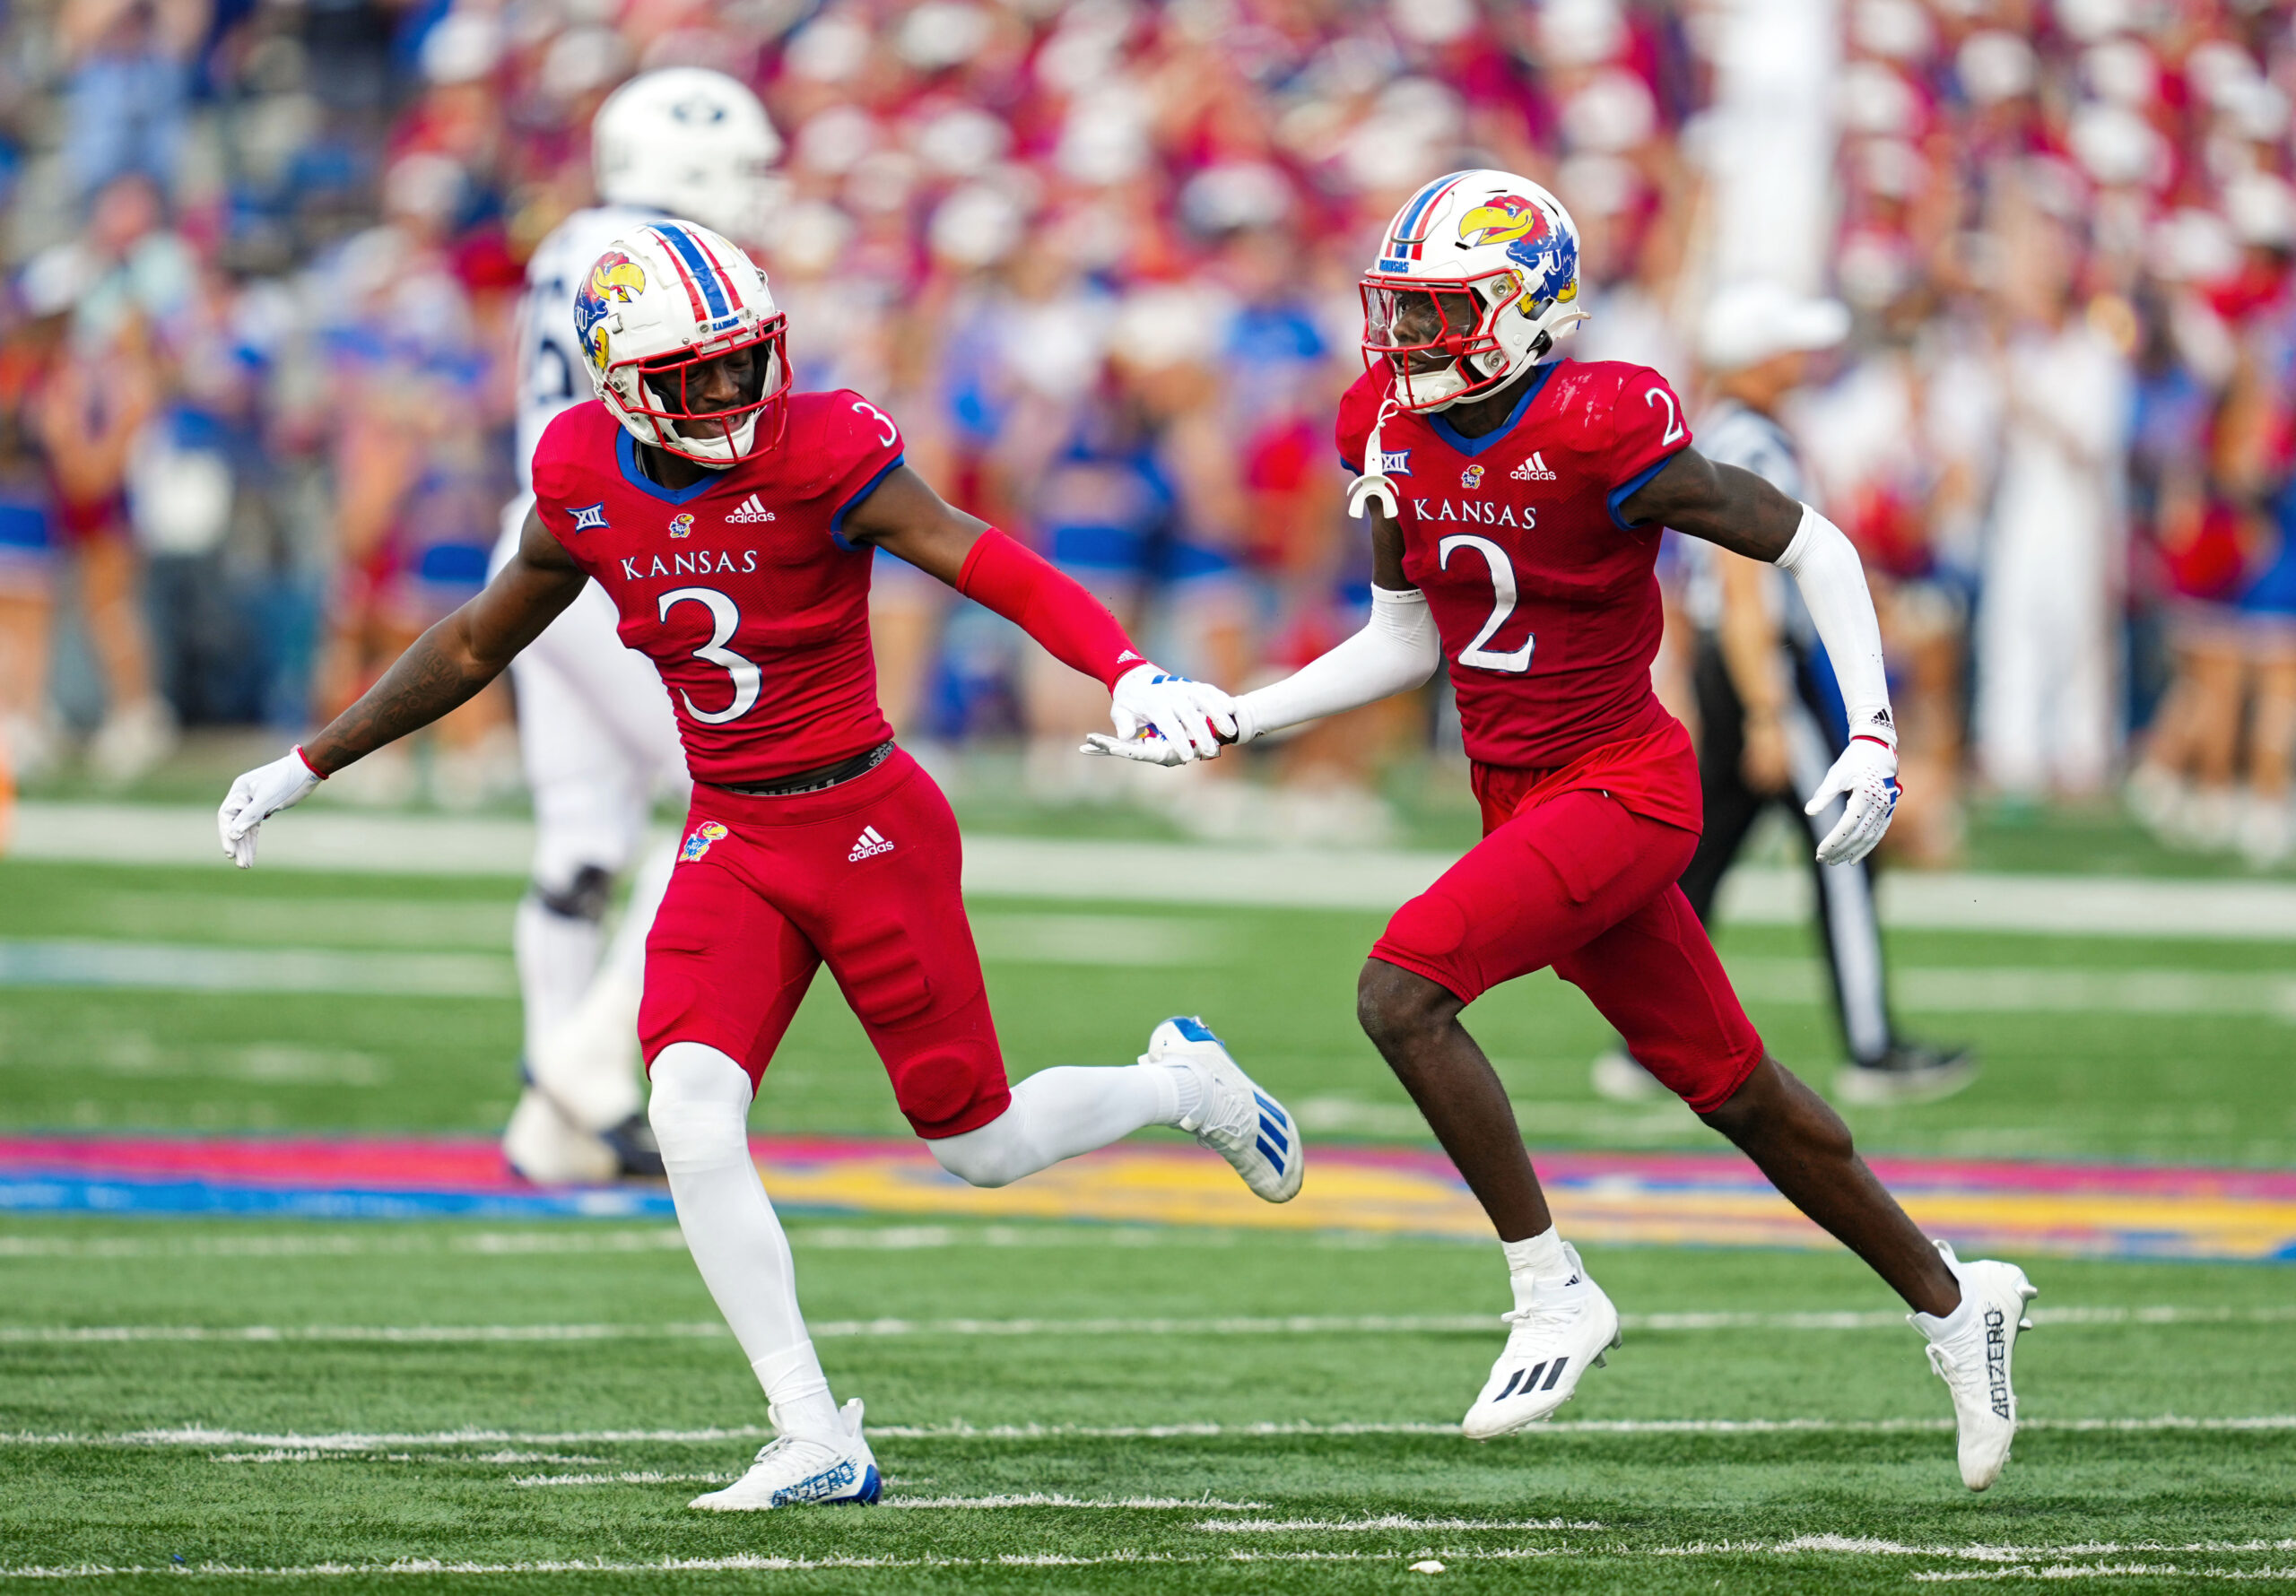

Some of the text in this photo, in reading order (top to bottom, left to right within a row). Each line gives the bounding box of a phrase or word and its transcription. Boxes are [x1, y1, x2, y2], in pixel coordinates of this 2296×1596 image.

[1378, 259, 1409, 273] KANSAS
[575, 306, 588, 333] KU
[712, 317, 739, 331] KANSAS
[852, 402, 897, 447] 3
[1644, 387, 1684, 447] 2
[1509, 469, 1557, 481] adidas
[567, 504, 607, 531] XII
[725, 512, 776, 524] adidas
[1413, 498, 1536, 530] KANSAS
[619, 550, 758, 581] KANSAS
[1439, 533, 1535, 674] 2
[657, 585, 761, 725] 3
[848, 840, 894, 863] adidas
[1984, 1306, 2010, 1420] ADIZERO
